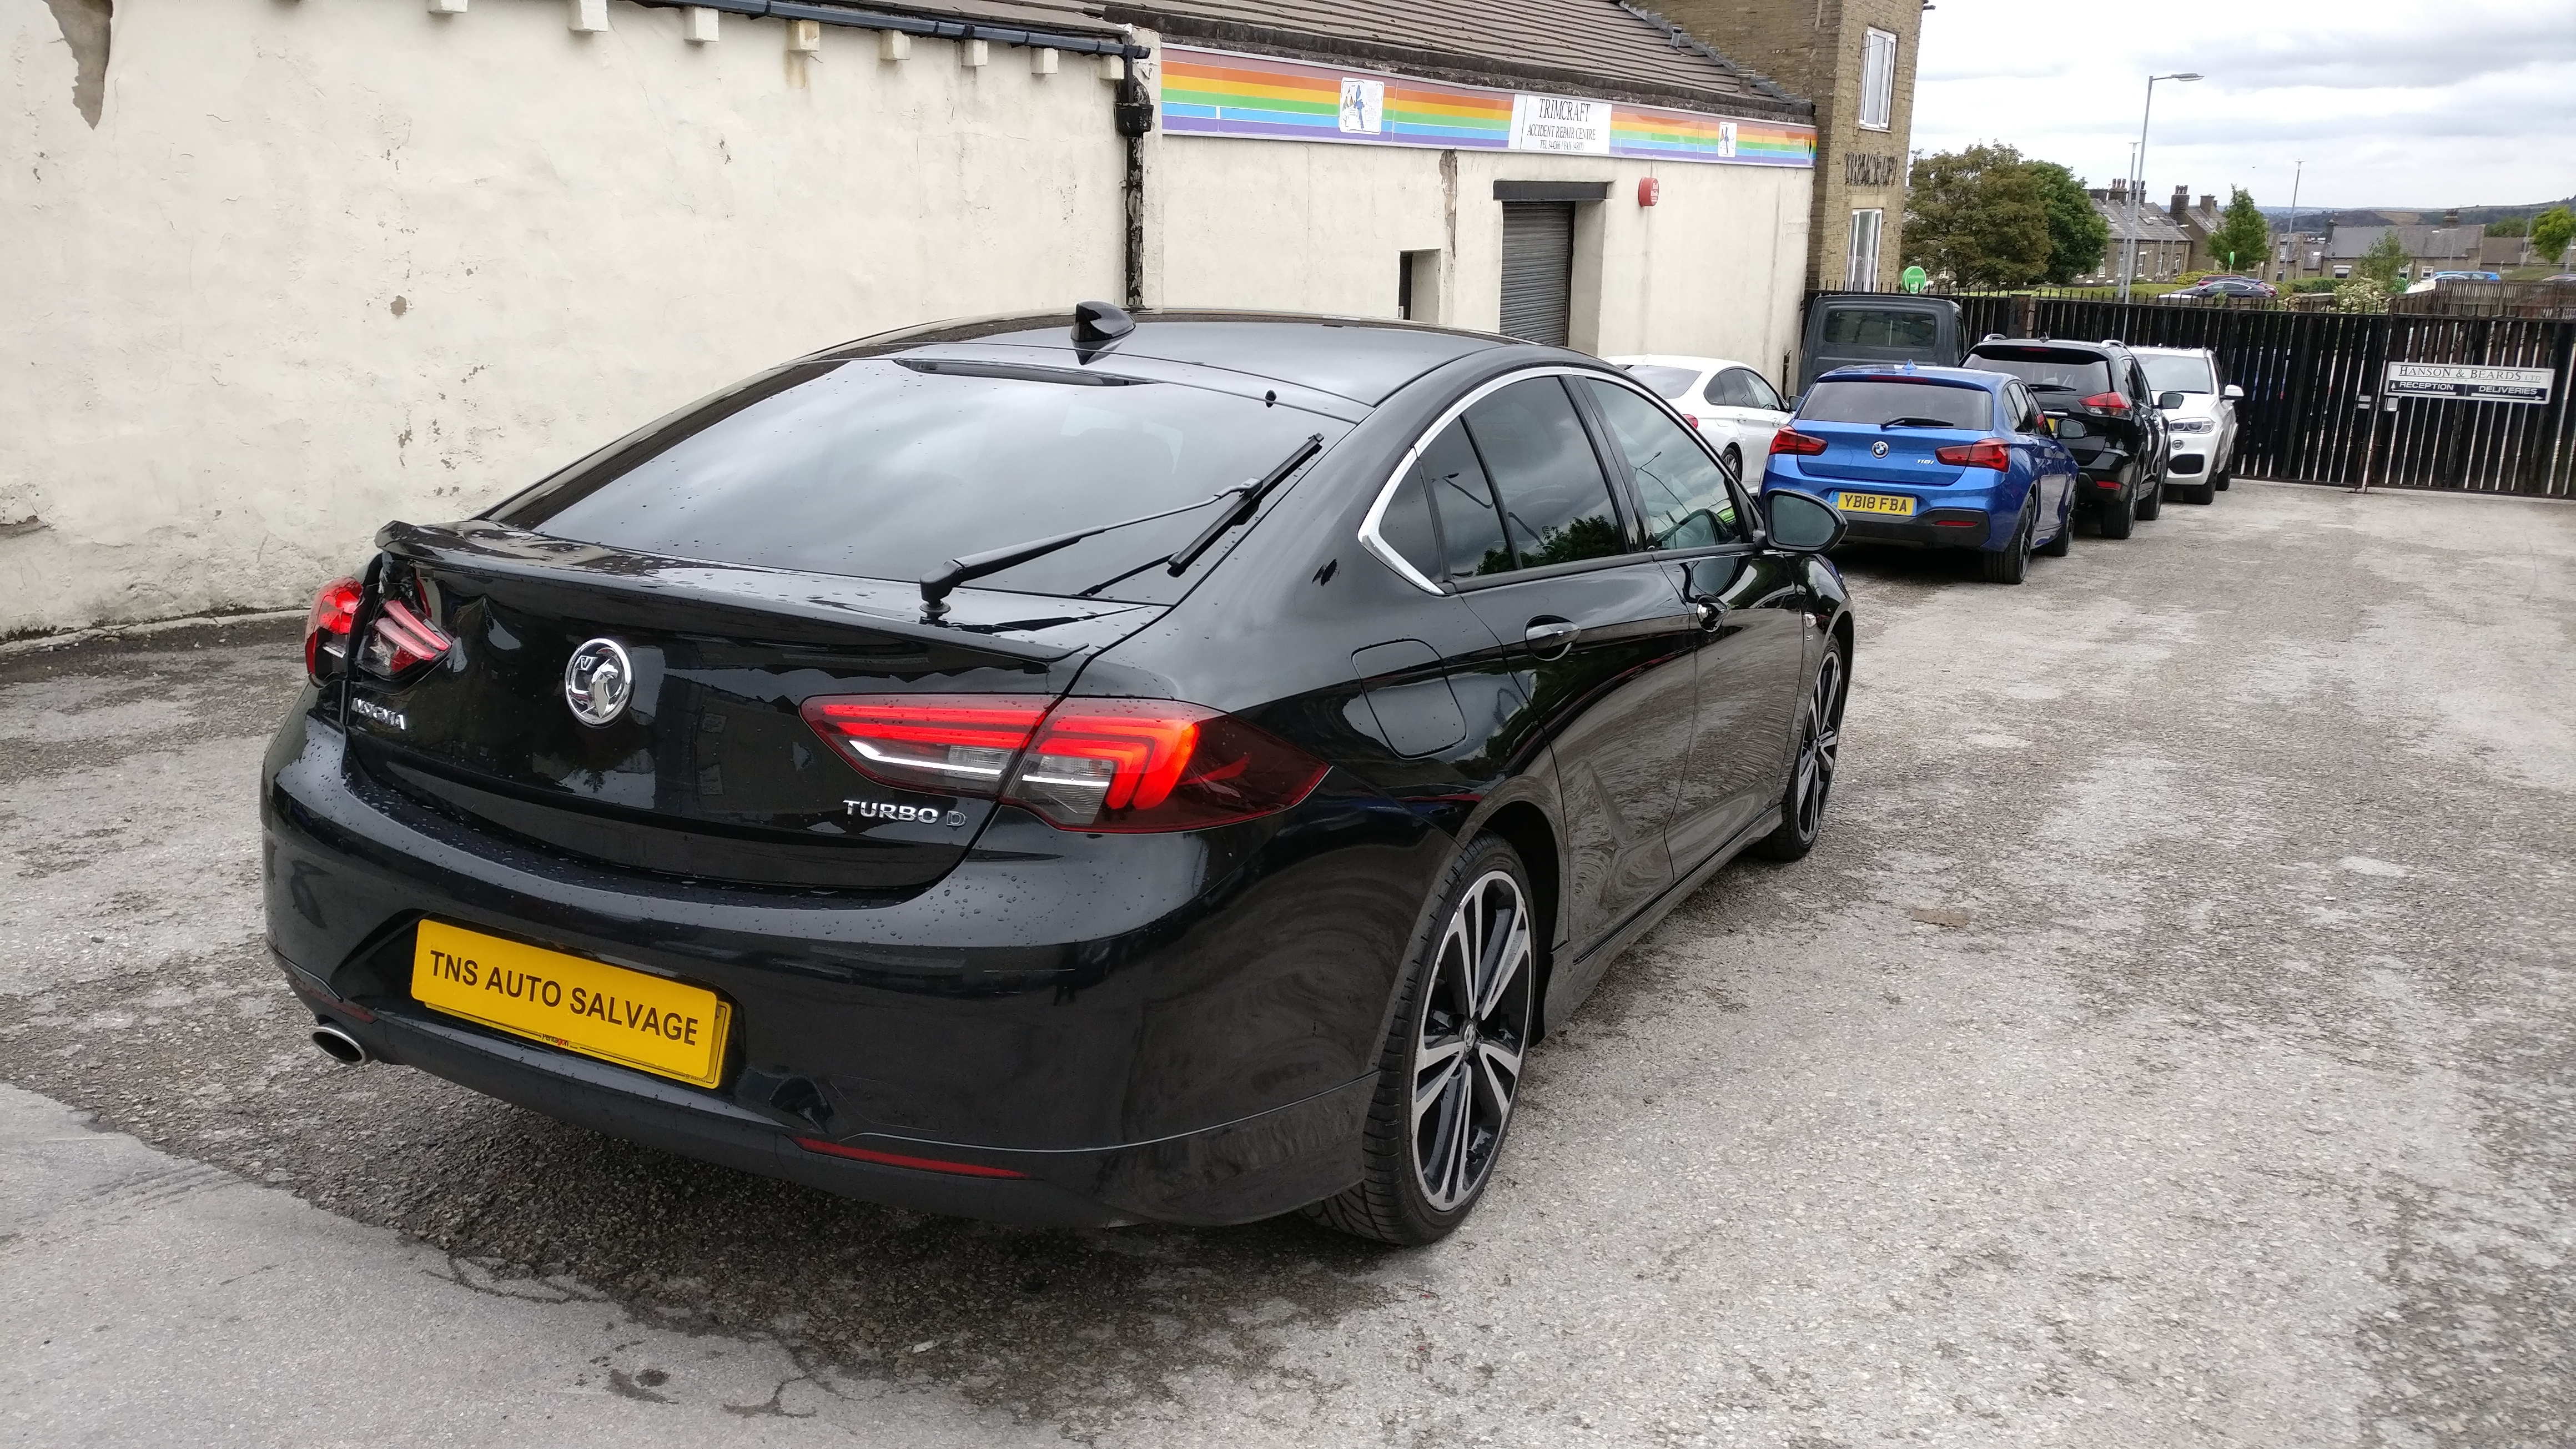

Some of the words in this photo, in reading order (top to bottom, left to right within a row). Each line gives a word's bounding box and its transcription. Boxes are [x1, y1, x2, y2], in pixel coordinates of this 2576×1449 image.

[1539, 98, 1591, 122] TRIMCRAFT
[1527, 124, 1555, 138] ACCIDENT
[1556, 126, 1574, 139] REPAIR
[1576, 128, 1596, 140] CENTRE
[2399, 366, 2451, 377] HANSON
[2456, 369, 2465, 378] &
[2471, 370, 2522, 380] BEARDS
[2399, 381, 2454, 391] RECEPTION
[2479, 385, 2538, 395] DELIVERIES
[1845, 494, 1876, 509] YB18
[1879, 497, 1907, 512] FBA
[843, 799, 939, 823] TURBO
[946, 811, 967, 826] D
[430, 950, 477, 987] TNS
[485, 966, 561, 1007] AUTO
[569, 987, 698, 1046] SALVAGE
